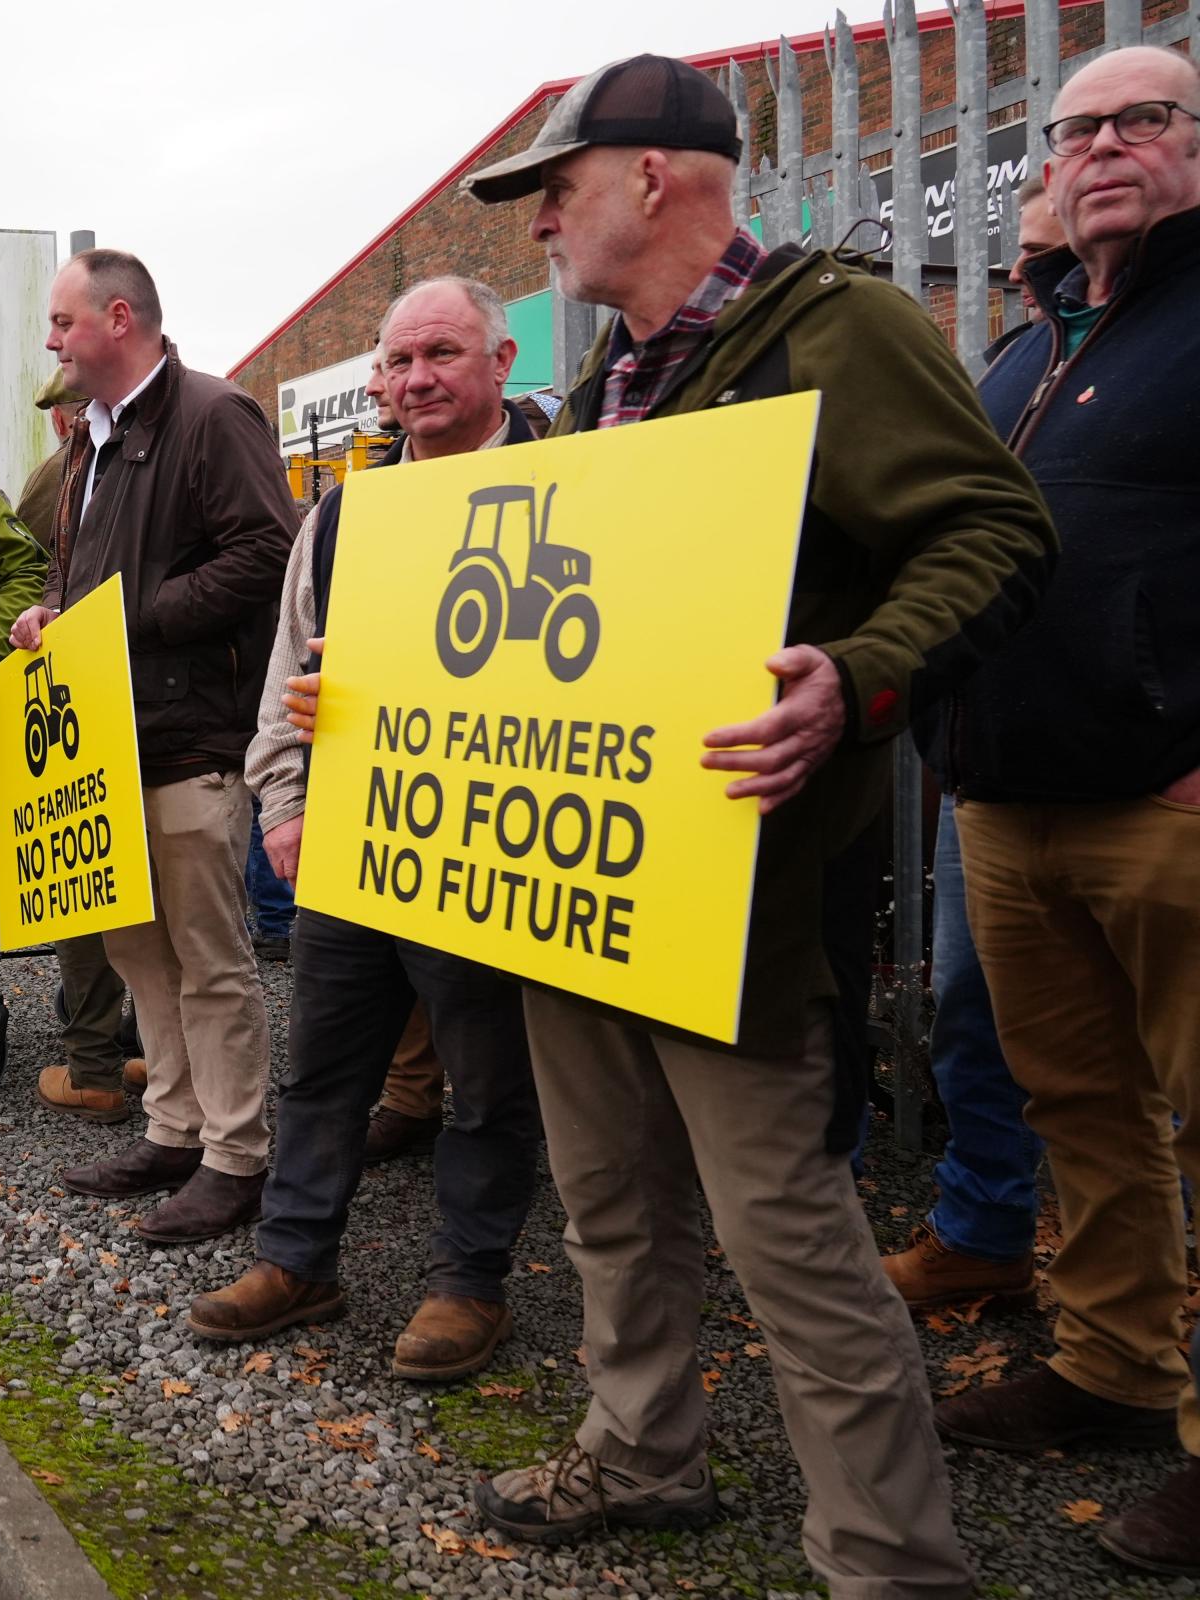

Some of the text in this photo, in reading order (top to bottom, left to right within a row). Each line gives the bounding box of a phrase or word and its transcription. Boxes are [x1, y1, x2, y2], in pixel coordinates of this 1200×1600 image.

[301, 385, 377, 430] RICKE
[360, 415, 378, 430] HOR
[374, 705, 656, 784] NO FARMERS
[13, 767, 107, 837] NO FARMERS
[365, 766, 645, 879] NO FOOD
[16, 813, 112, 886] NO FOOD
[19, 865, 117, 926] NO FUTURE
[358, 839, 635, 965] NO FUTURE
